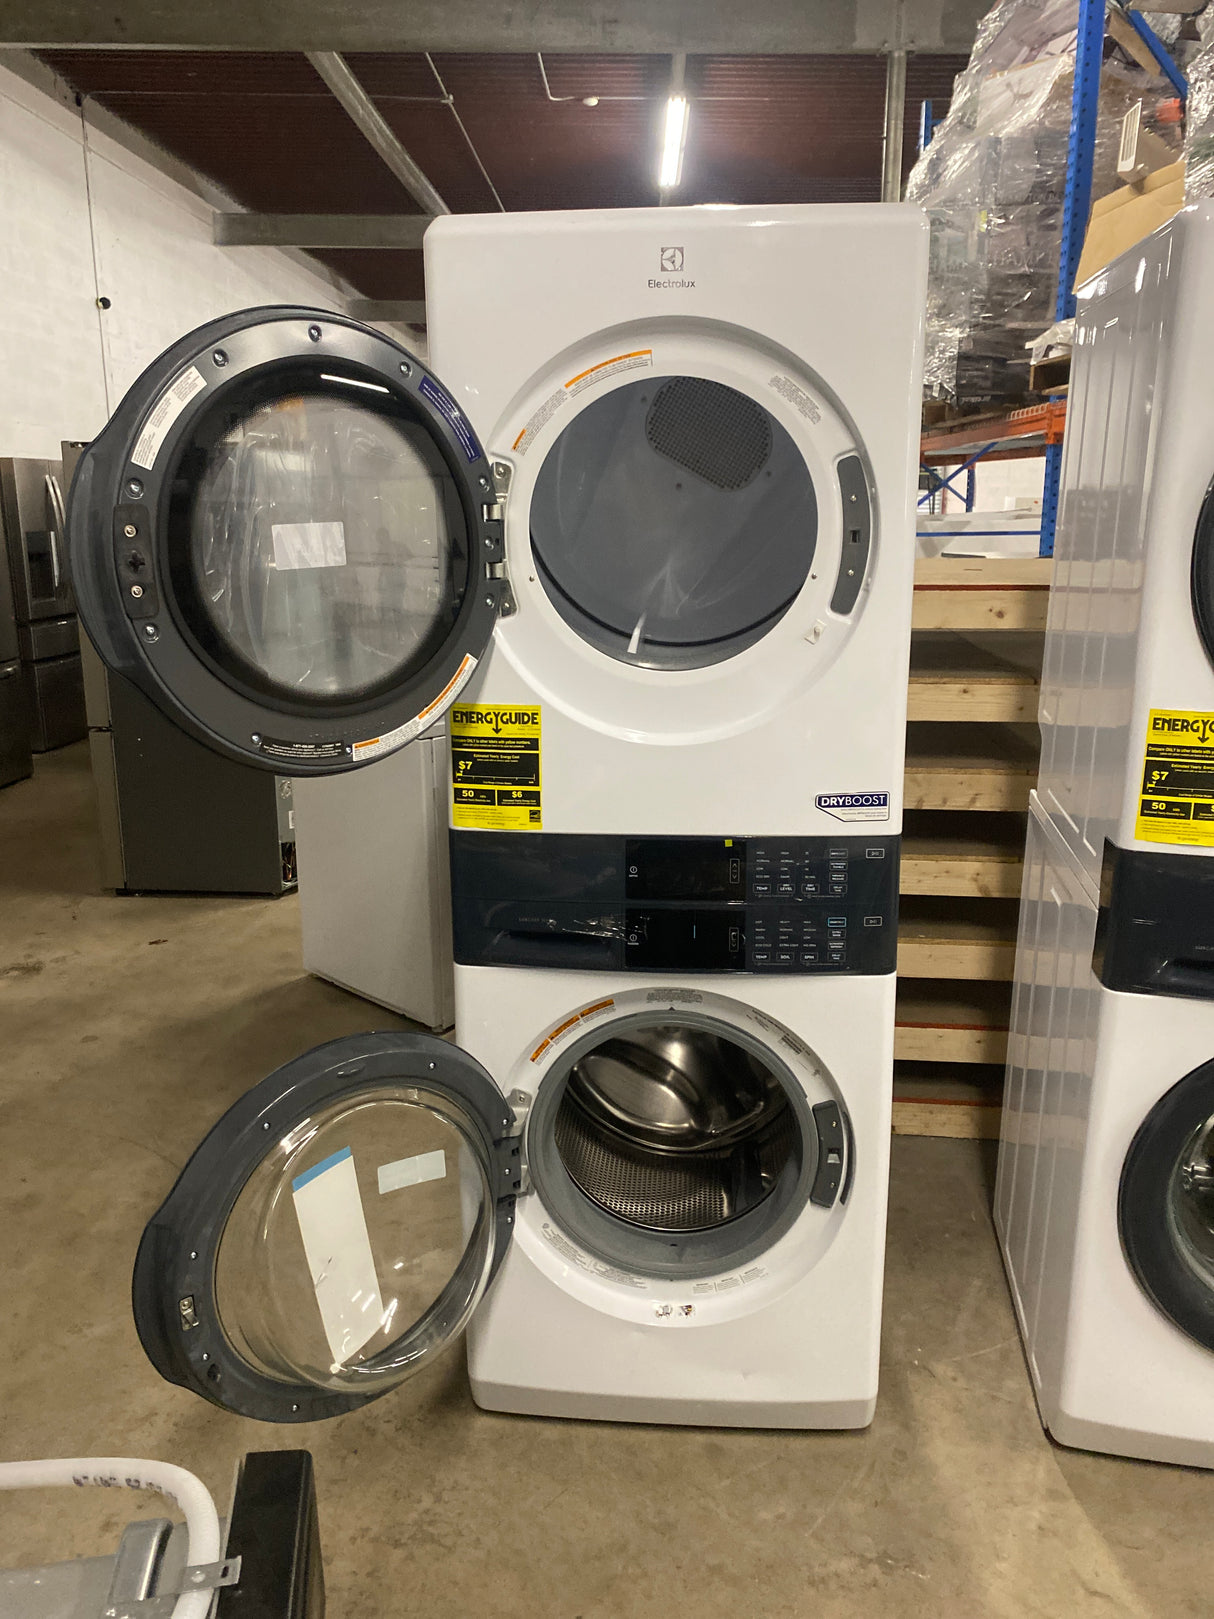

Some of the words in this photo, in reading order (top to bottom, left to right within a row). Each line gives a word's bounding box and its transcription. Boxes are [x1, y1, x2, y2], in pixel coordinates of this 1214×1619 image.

[647, 279, 696, 289] Electrolux
[452, 710, 539, 725] ENERGYGUIDE
[458, 760, 473, 770] $7
[1151, 770, 1169, 781] $7
[462, 789, 475, 798] 50
[511, 790, 523, 799] $6
[821, 795, 886, 806] DRYBOOST
[1151, 801, 1167, 811] 50
